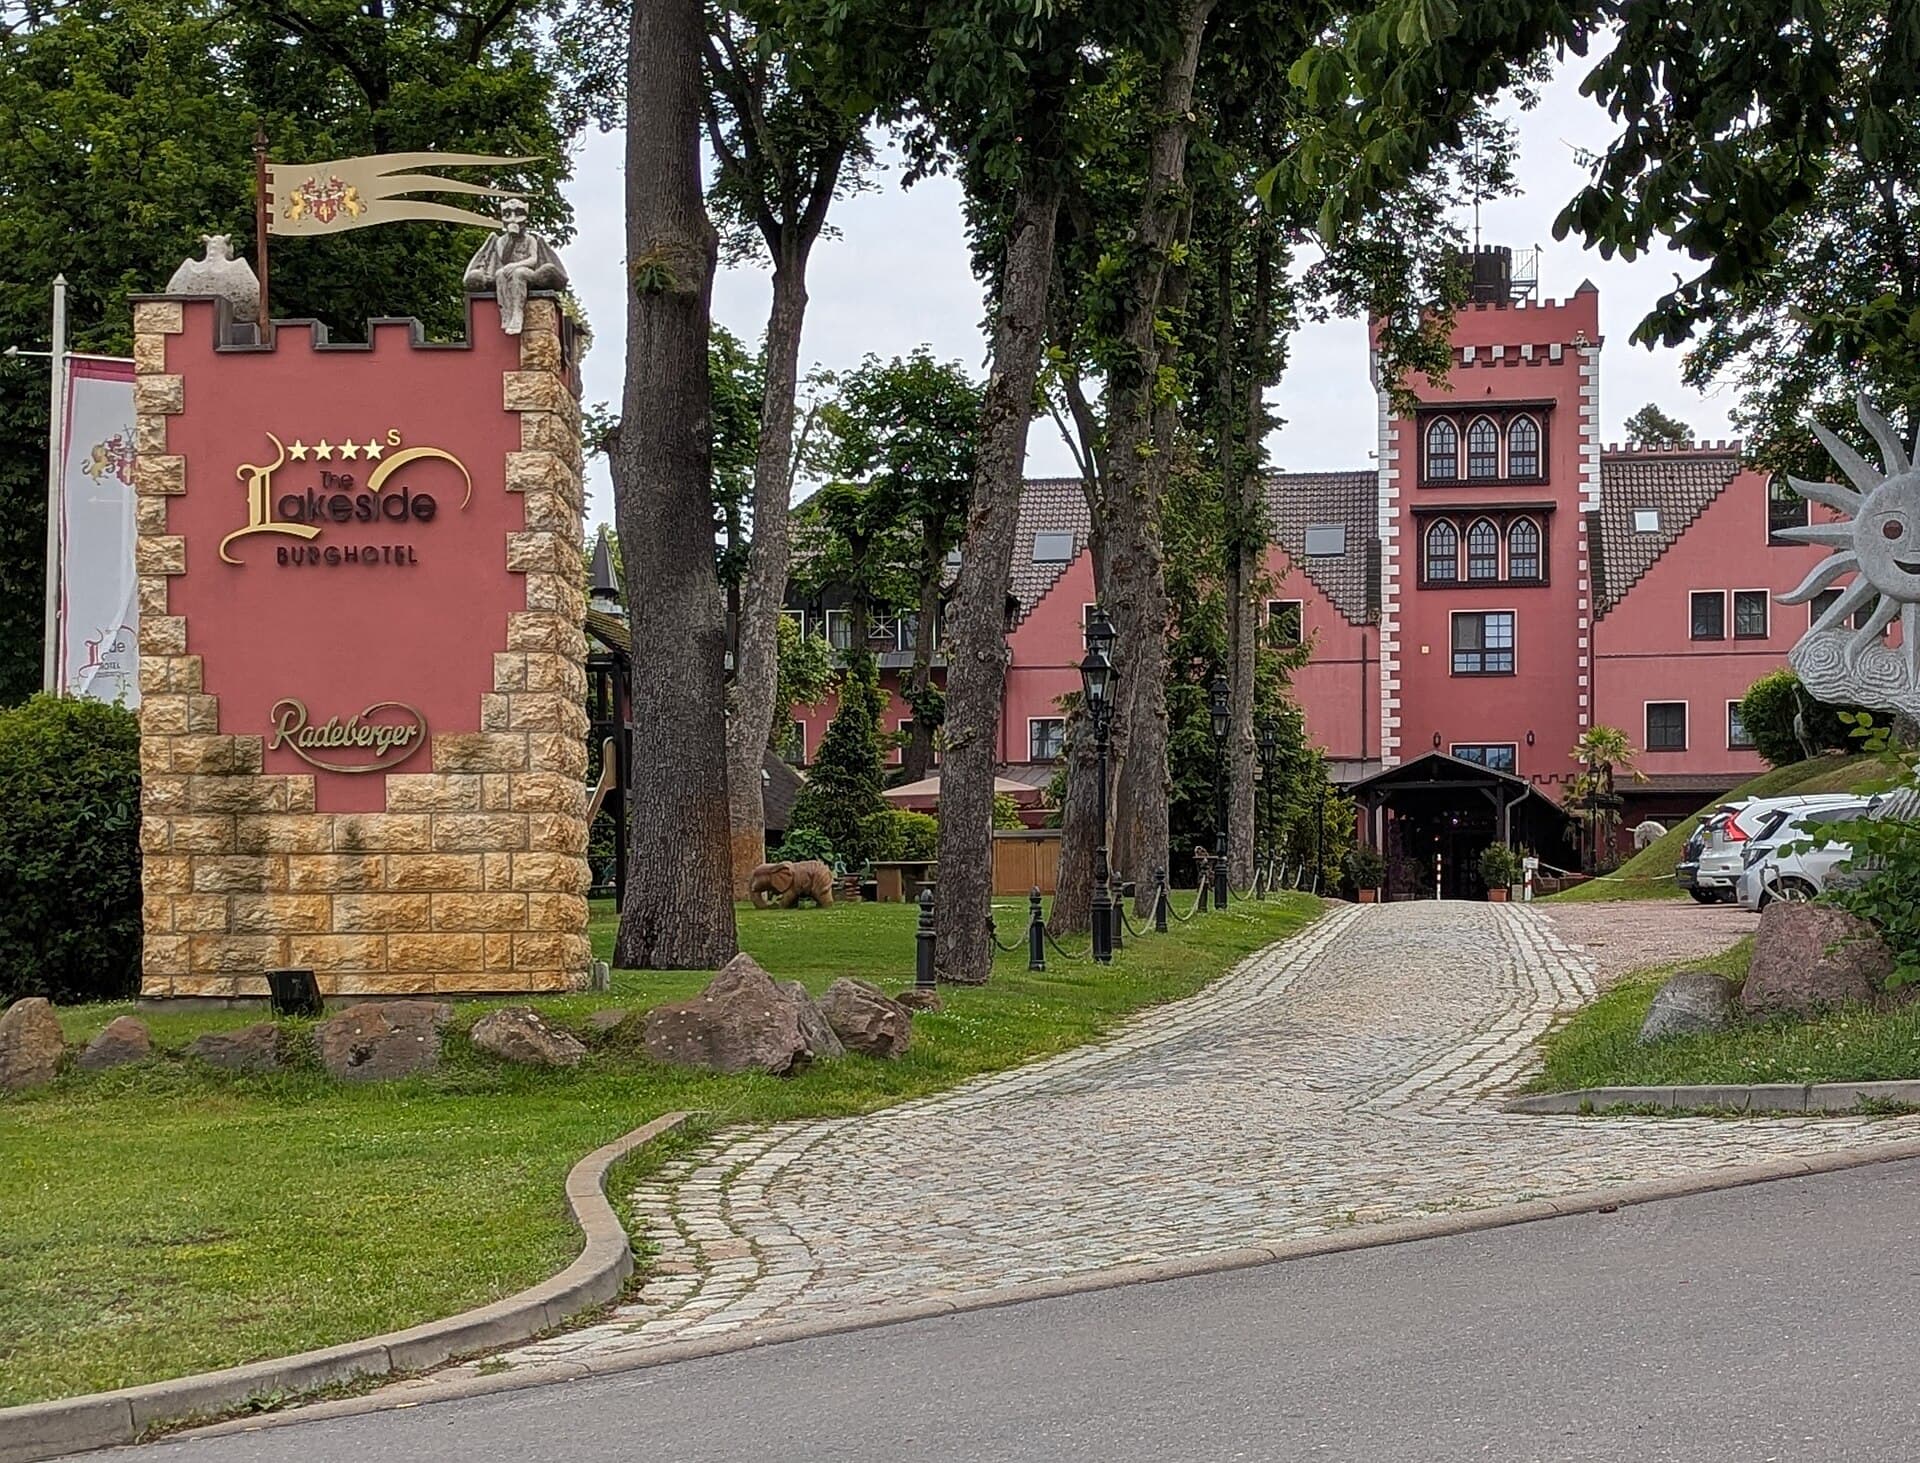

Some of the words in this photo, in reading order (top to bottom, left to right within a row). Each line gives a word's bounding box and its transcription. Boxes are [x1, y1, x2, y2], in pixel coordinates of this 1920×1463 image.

[219, 432, 437, 564] Lakeside
[320, 470, 354, 490] The
[276, 545, 418, 565] BURGHOTEL
[268, 697, 427, 772] Radeberger
